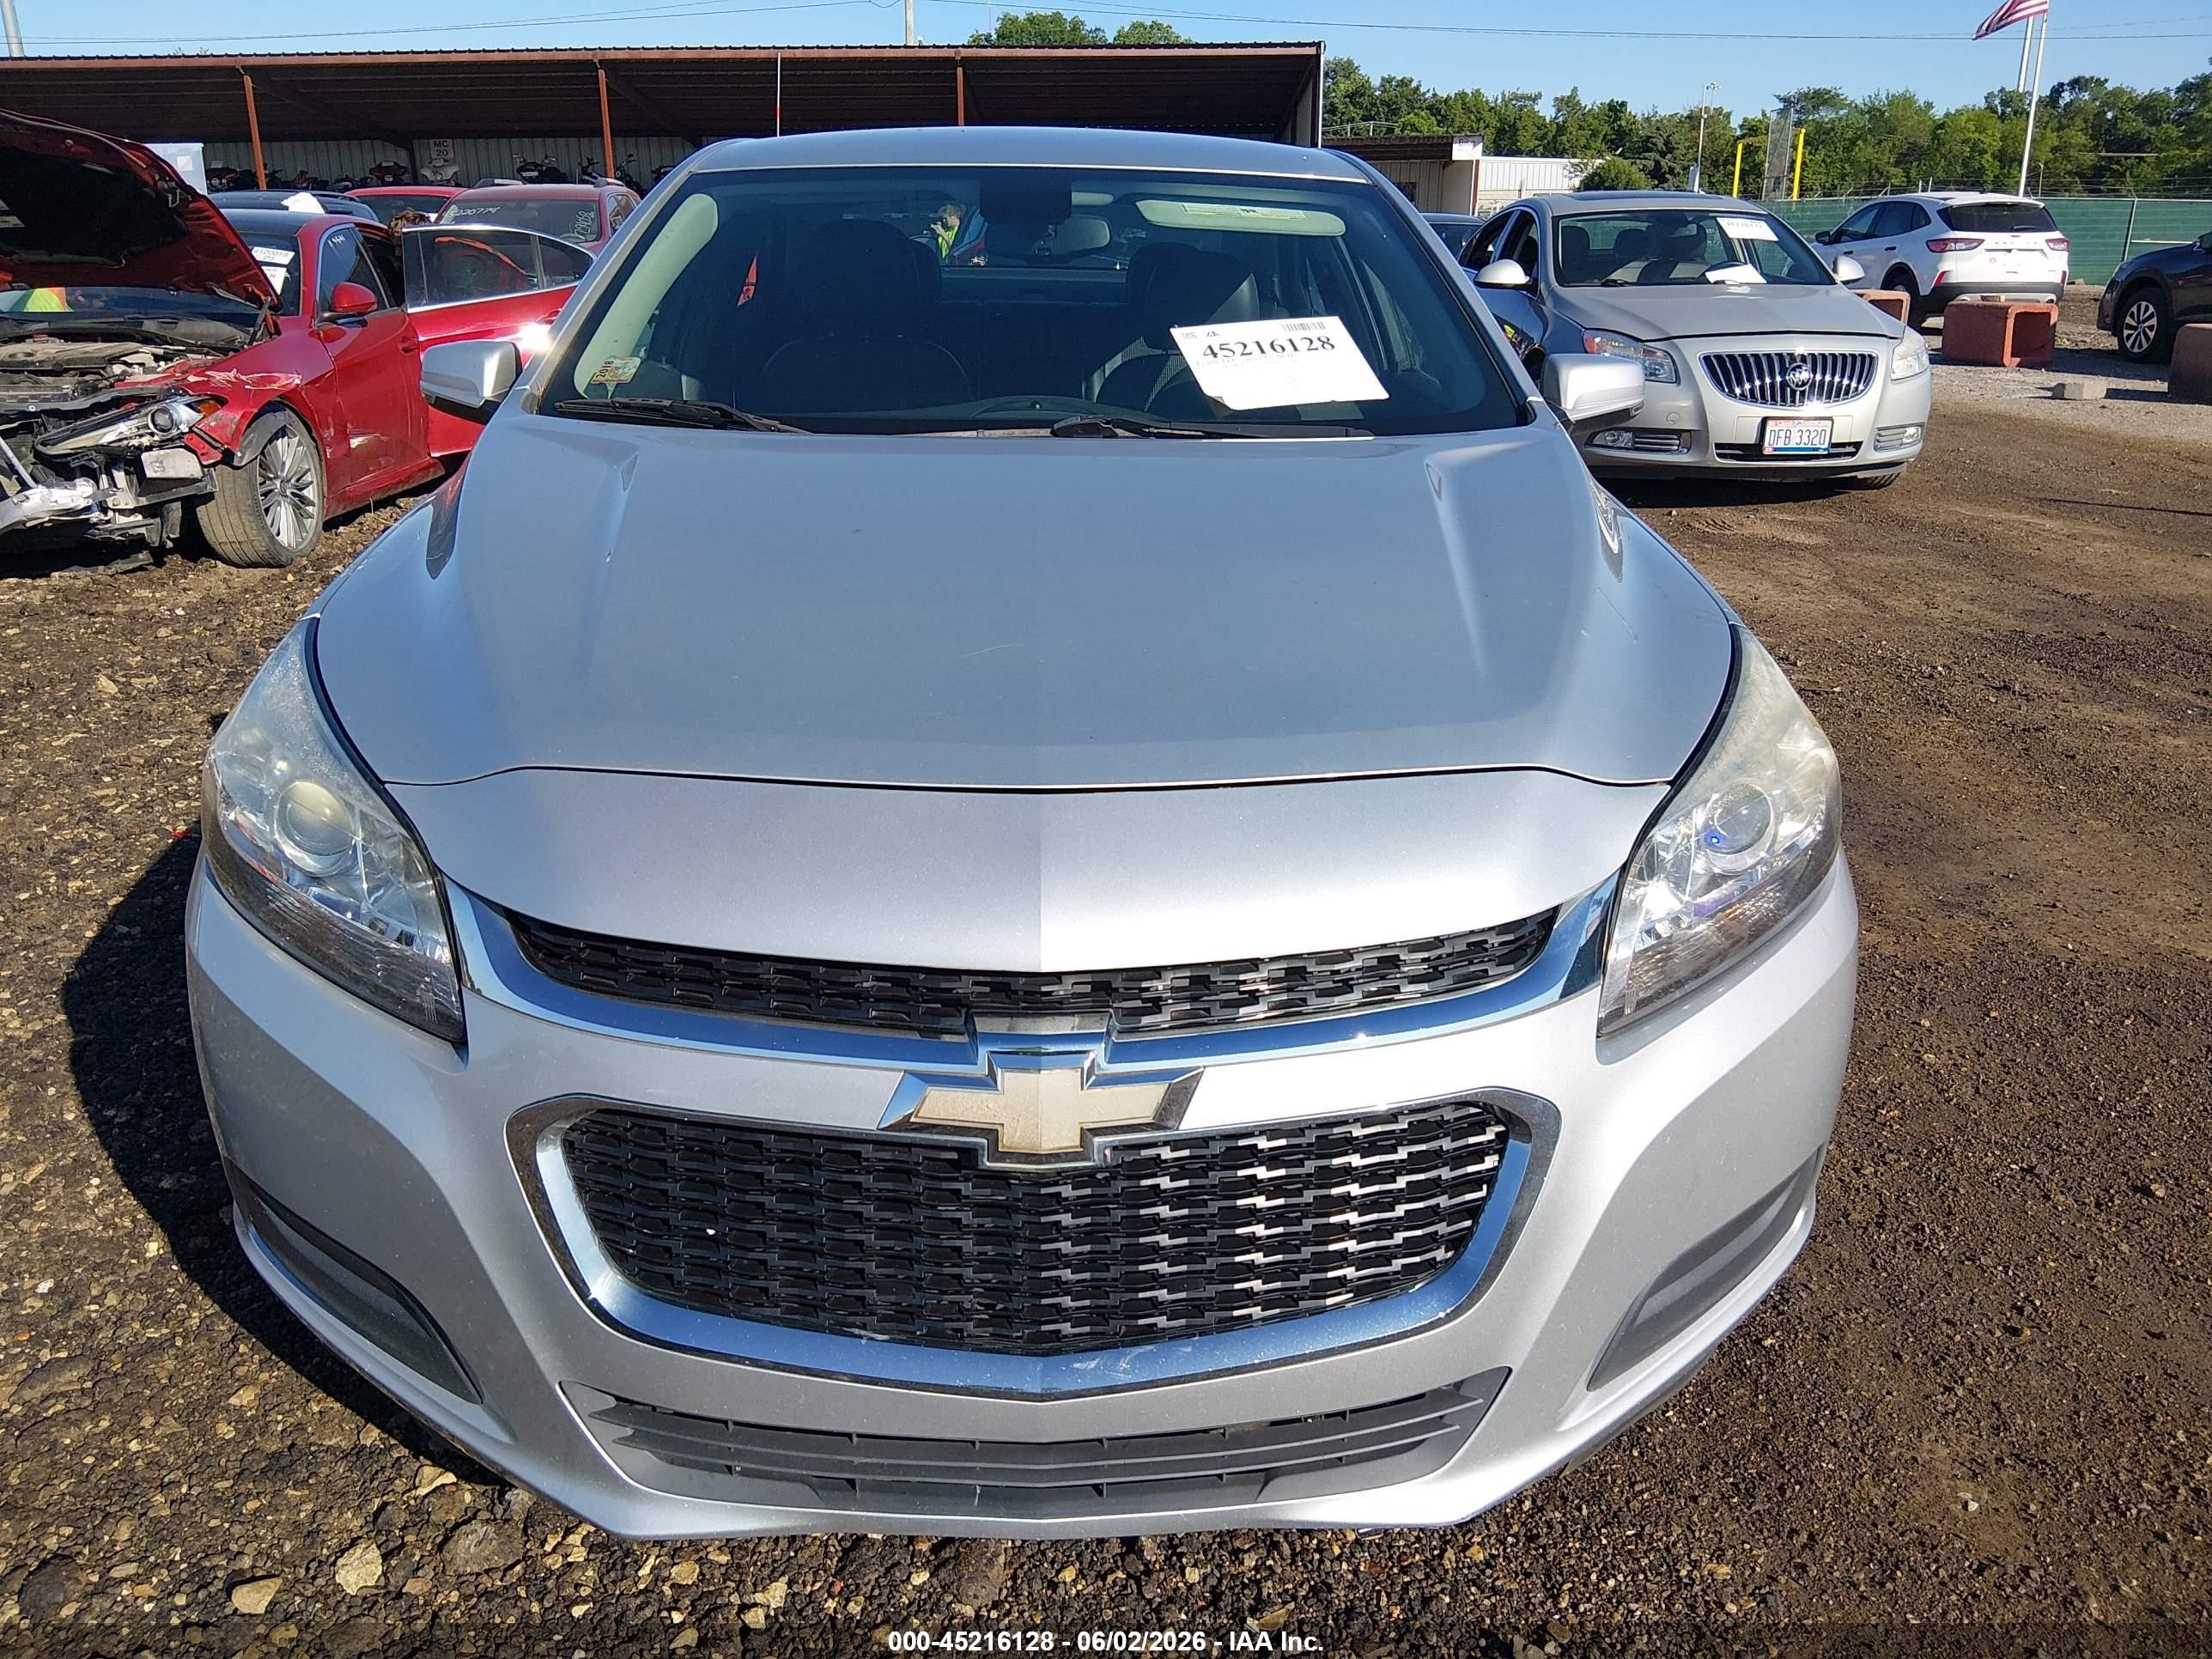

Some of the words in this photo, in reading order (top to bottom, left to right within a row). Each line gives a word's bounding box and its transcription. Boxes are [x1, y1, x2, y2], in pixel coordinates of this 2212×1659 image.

[1203, 336, 1335, 359] 45216128
[595, 361, 615, 378] 2018
[1768, 428, 1792, 446] DFB
[1795, 428, 1826, 446] 3320
